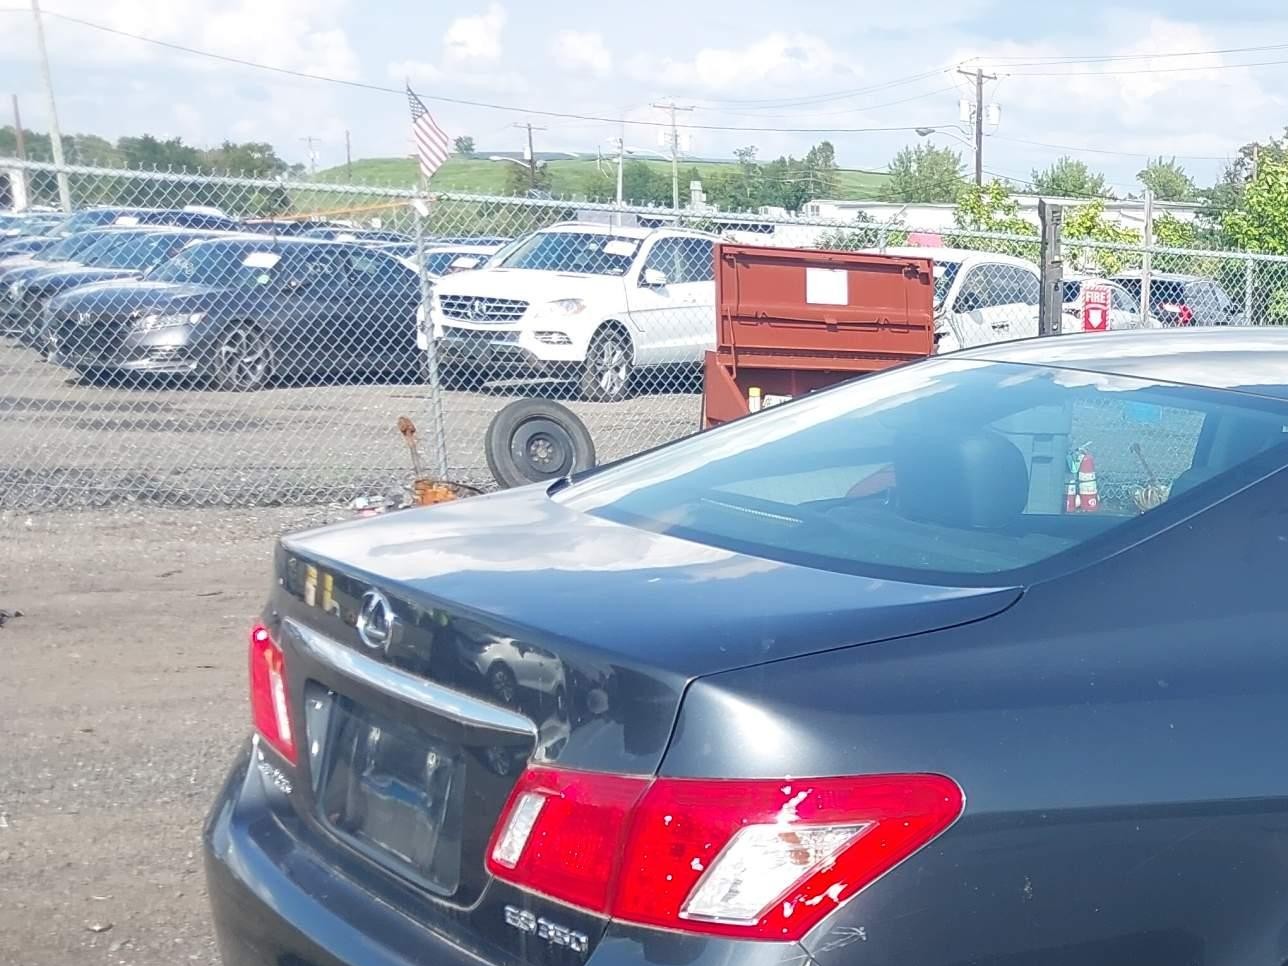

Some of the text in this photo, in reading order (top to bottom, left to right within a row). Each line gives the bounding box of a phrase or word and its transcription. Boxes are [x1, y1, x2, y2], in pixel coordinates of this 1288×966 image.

[1086, 291, 1106, 302] FIRE
[504, 904, 589, 952] ES 350
